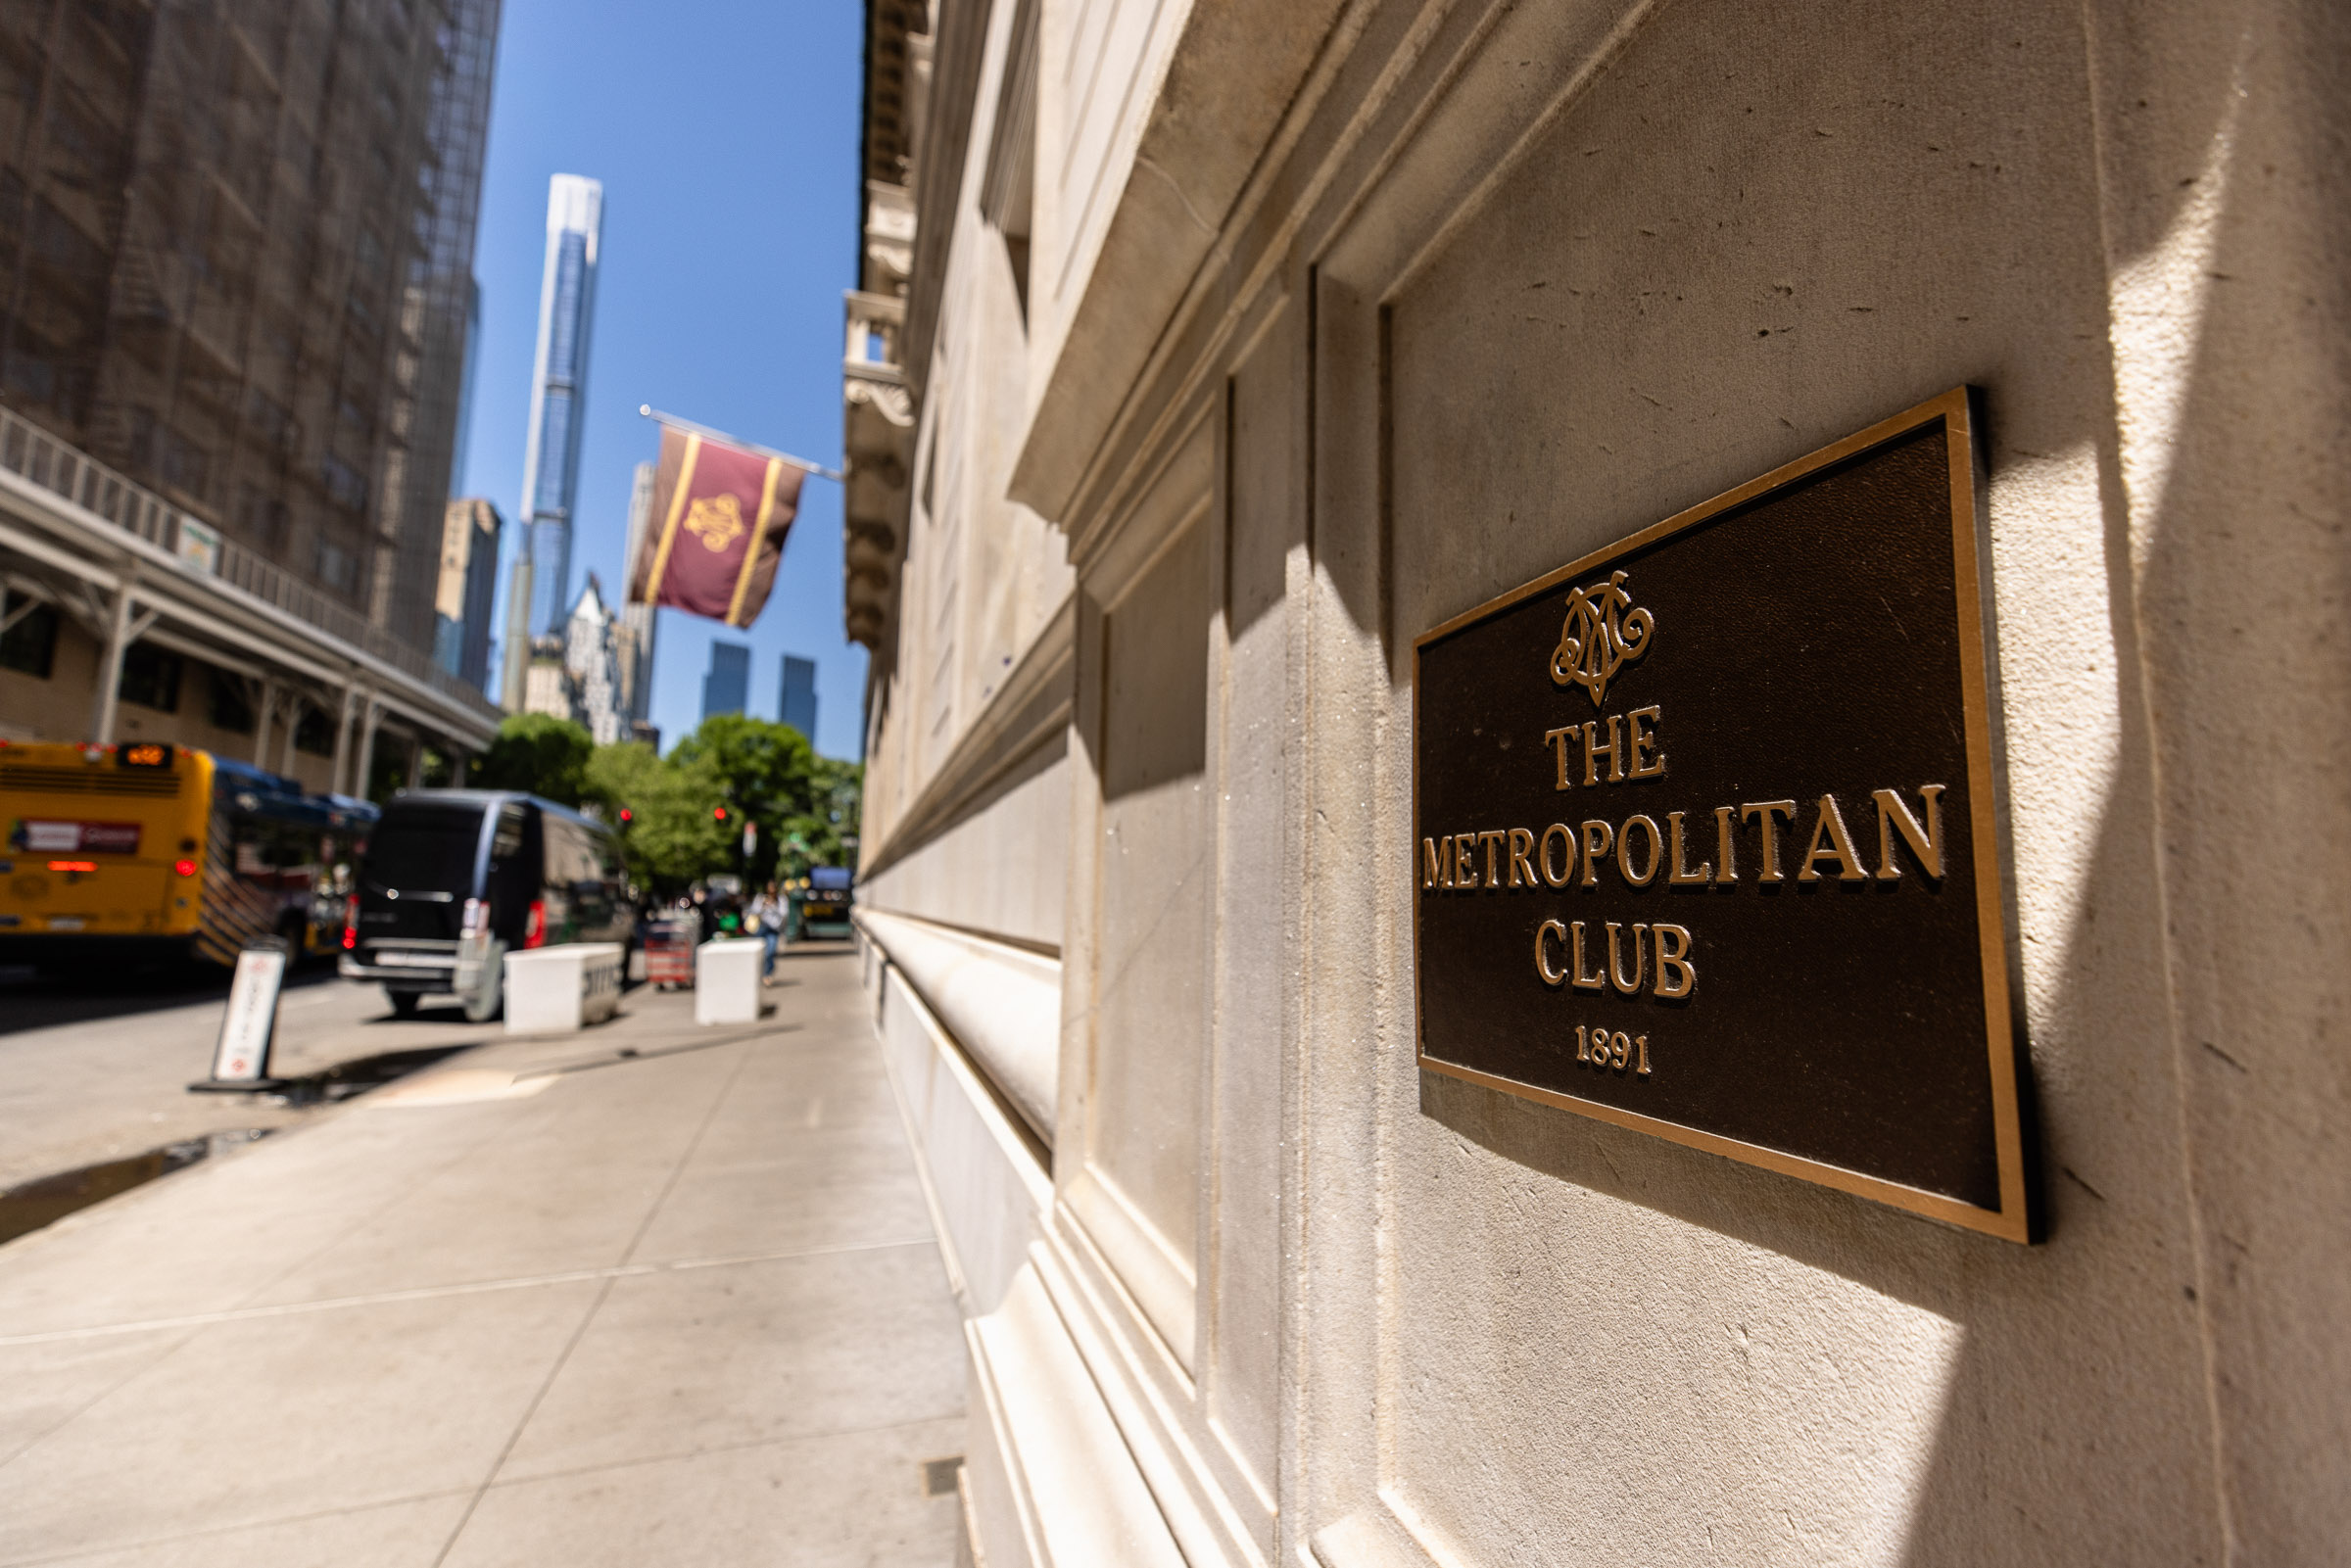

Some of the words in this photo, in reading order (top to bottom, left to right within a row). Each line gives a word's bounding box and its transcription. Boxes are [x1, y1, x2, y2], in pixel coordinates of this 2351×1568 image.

[1545, 704, 1665, 790] THE
[1423, 784, 1946, 888] METROPOLITAN
[1535, 920, 1697, 999] CLUB
[1575, 1024, 1652, 1075] 1891
